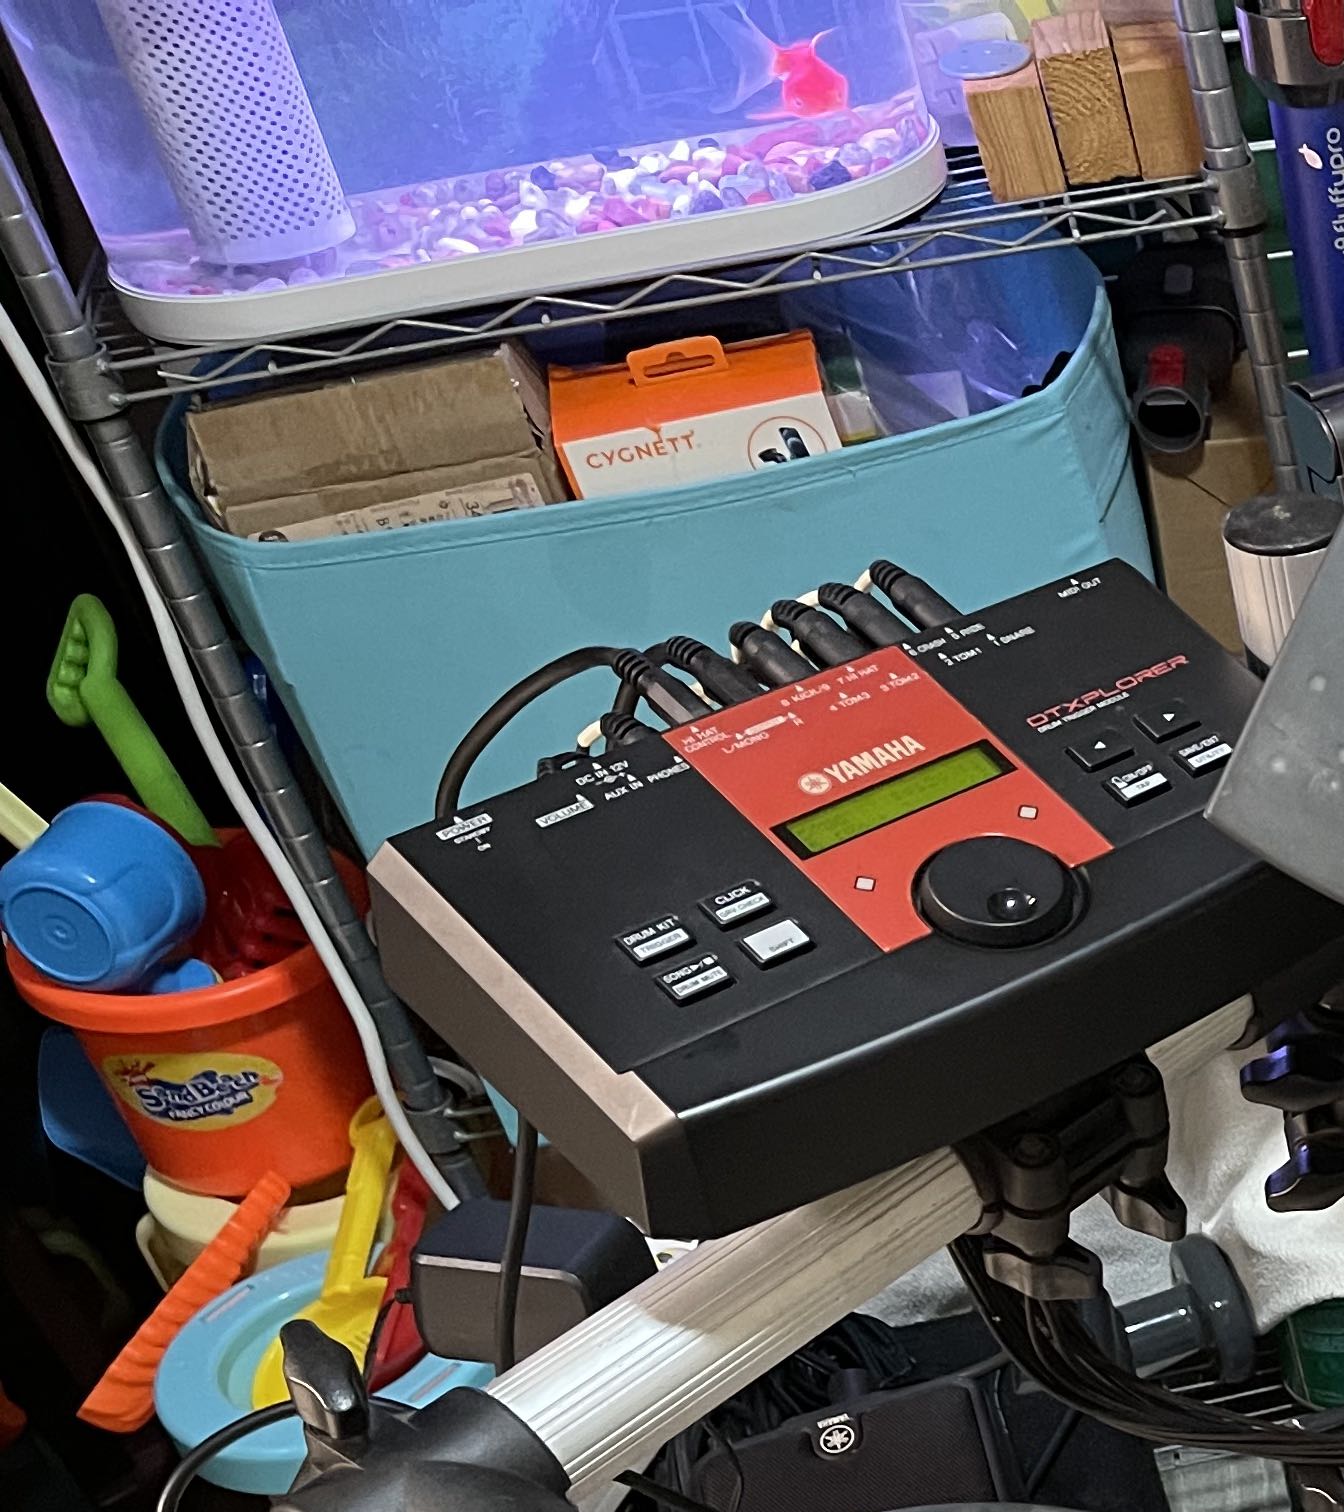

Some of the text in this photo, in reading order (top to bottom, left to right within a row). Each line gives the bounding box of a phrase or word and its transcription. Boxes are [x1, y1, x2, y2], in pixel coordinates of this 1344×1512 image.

[586, 433, 695, 469] CYGNETT
[1081, 577, 1101, 589] OUT
[823, 735, 927, 784] YAMAHA
[575, 760, 628, 786] DC IN 12V
[647, 762, 690, 783] PHONES
[604, 780, 644, 800] AUX IN
[538, 800, 590, 826] VOLUME
[441, 815, 489, 839] POWER
[714, 885, 751, 905] CLICK
[623, 918, 676, 946] DRUM KIT
